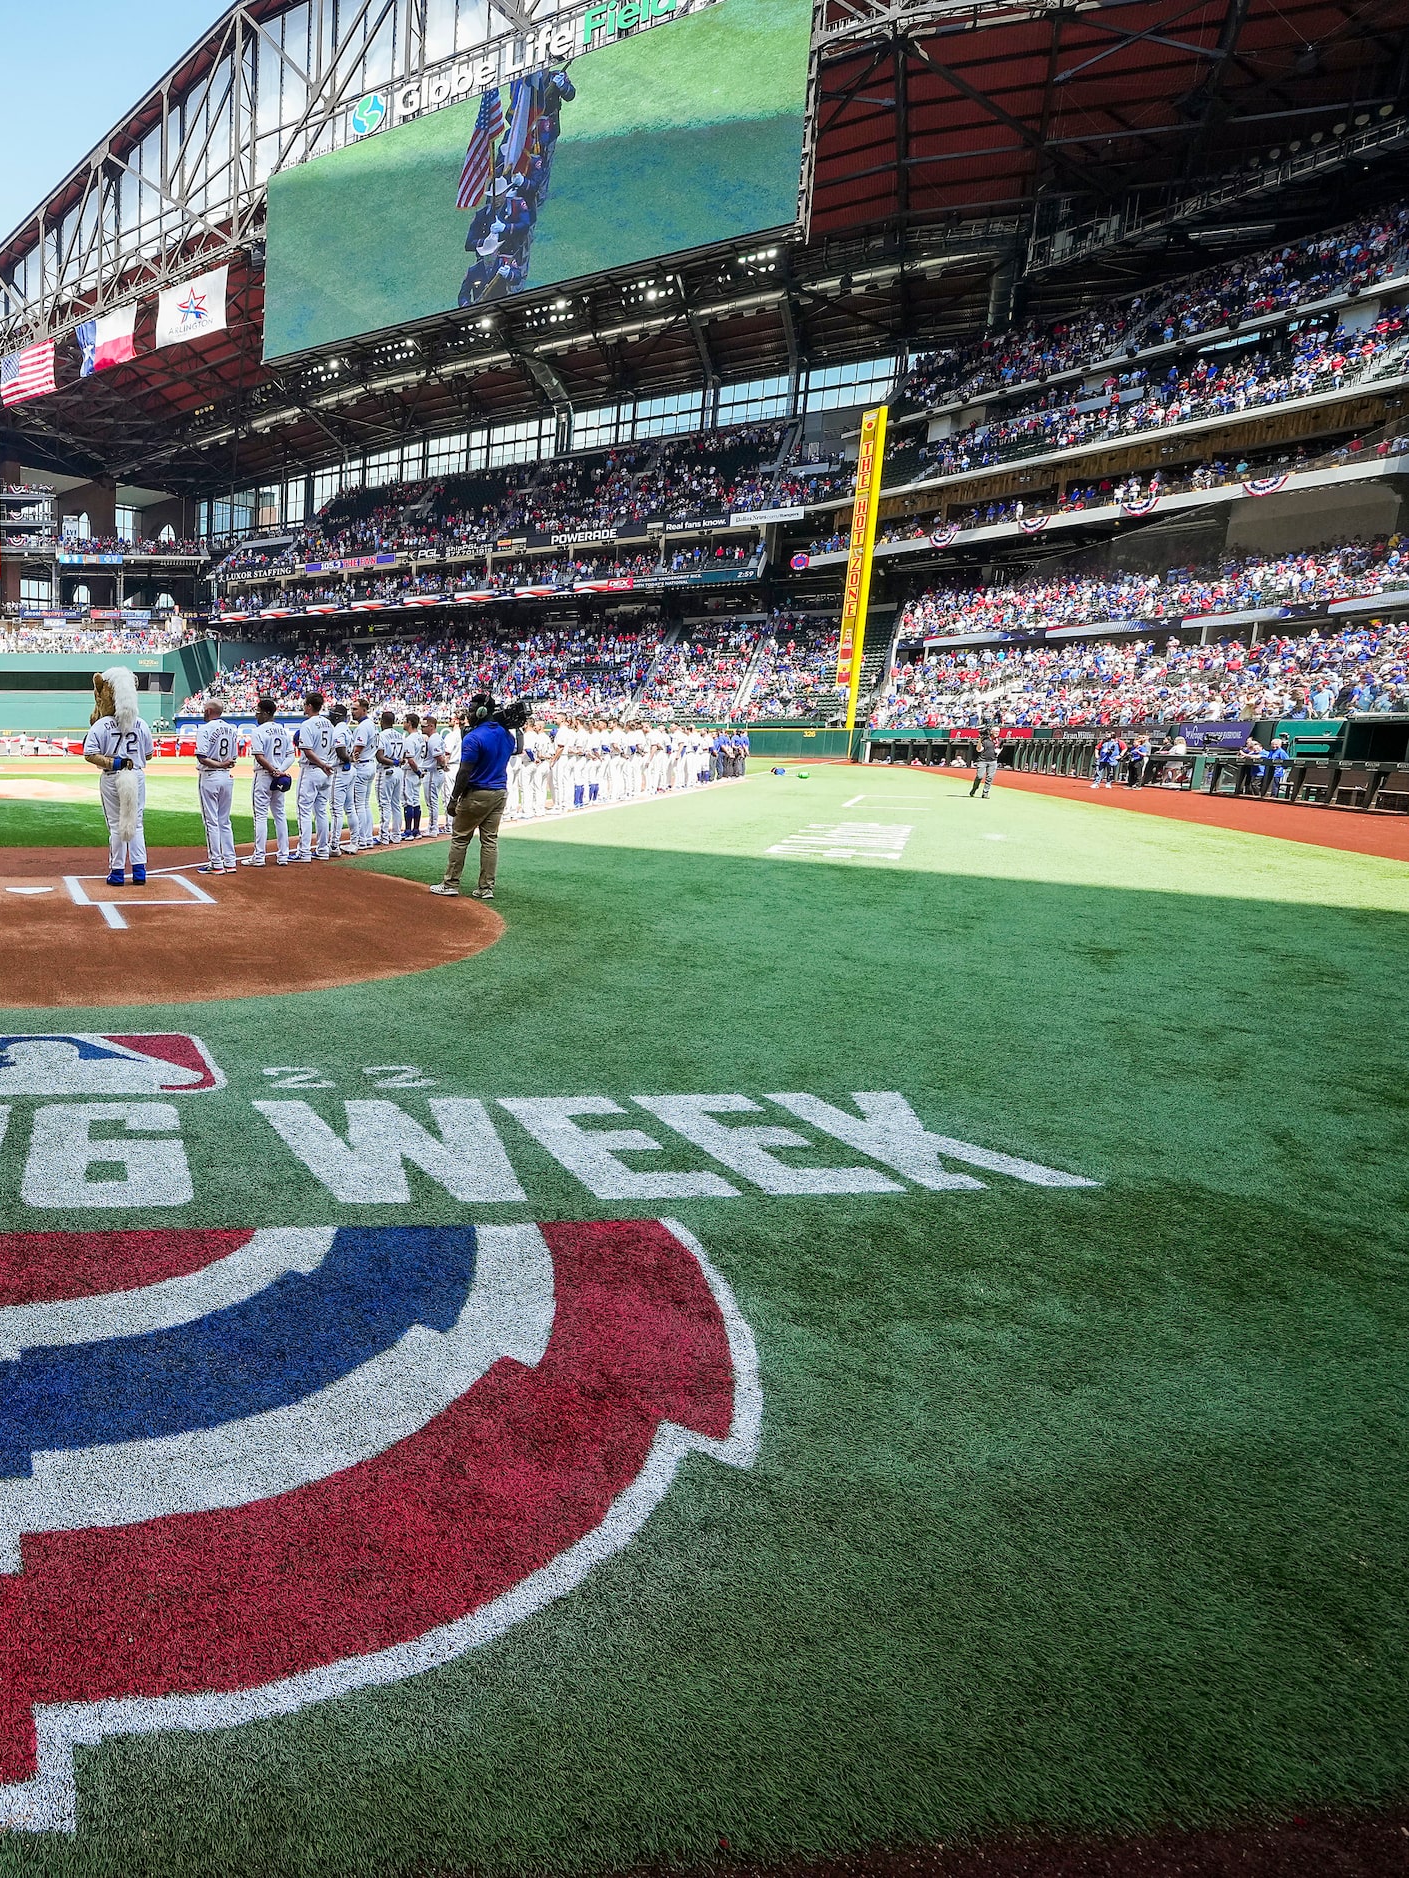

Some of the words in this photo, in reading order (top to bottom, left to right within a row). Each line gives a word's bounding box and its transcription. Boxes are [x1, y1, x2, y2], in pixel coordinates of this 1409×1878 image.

[394, 53, 498, 117] Globe
[504, 22, 574, 76] Life
[582, 0, 679, 46] Field
[860, 442, 873, 489] THE
[665, 522, 683, 531] Real
[684, 520, 702, 529] fans
[702, 517, 727, 528] know.
[854, 499, 867, 545] HOT
[551, 528, 618, 545] POWERADE
[417, 548, 441, 559] PGL
[445, 543, 494, 553] ShipPGL.com
[320, 562, 341, 570] 105.3
[342, 559, 358, 568] THE
[360, 557, 376, 567] FAN
[225, 570, 253, 582] LUXOR
[253, 566, 292, 578] STAFFING
[737, 571, 755, 579] 2:59
[609, 579, 629, 588] DEX
[847, 557, 860, 617] ZONE
[111, 731, 138, 754] 72
[219, 738, 229, 757] 8
[273, 737, 282, 756] 2
[321, 730, 329, 748] 5
[391, 742, 404, 758] 77
[253, 1089, 1104, 1204] WEEK
